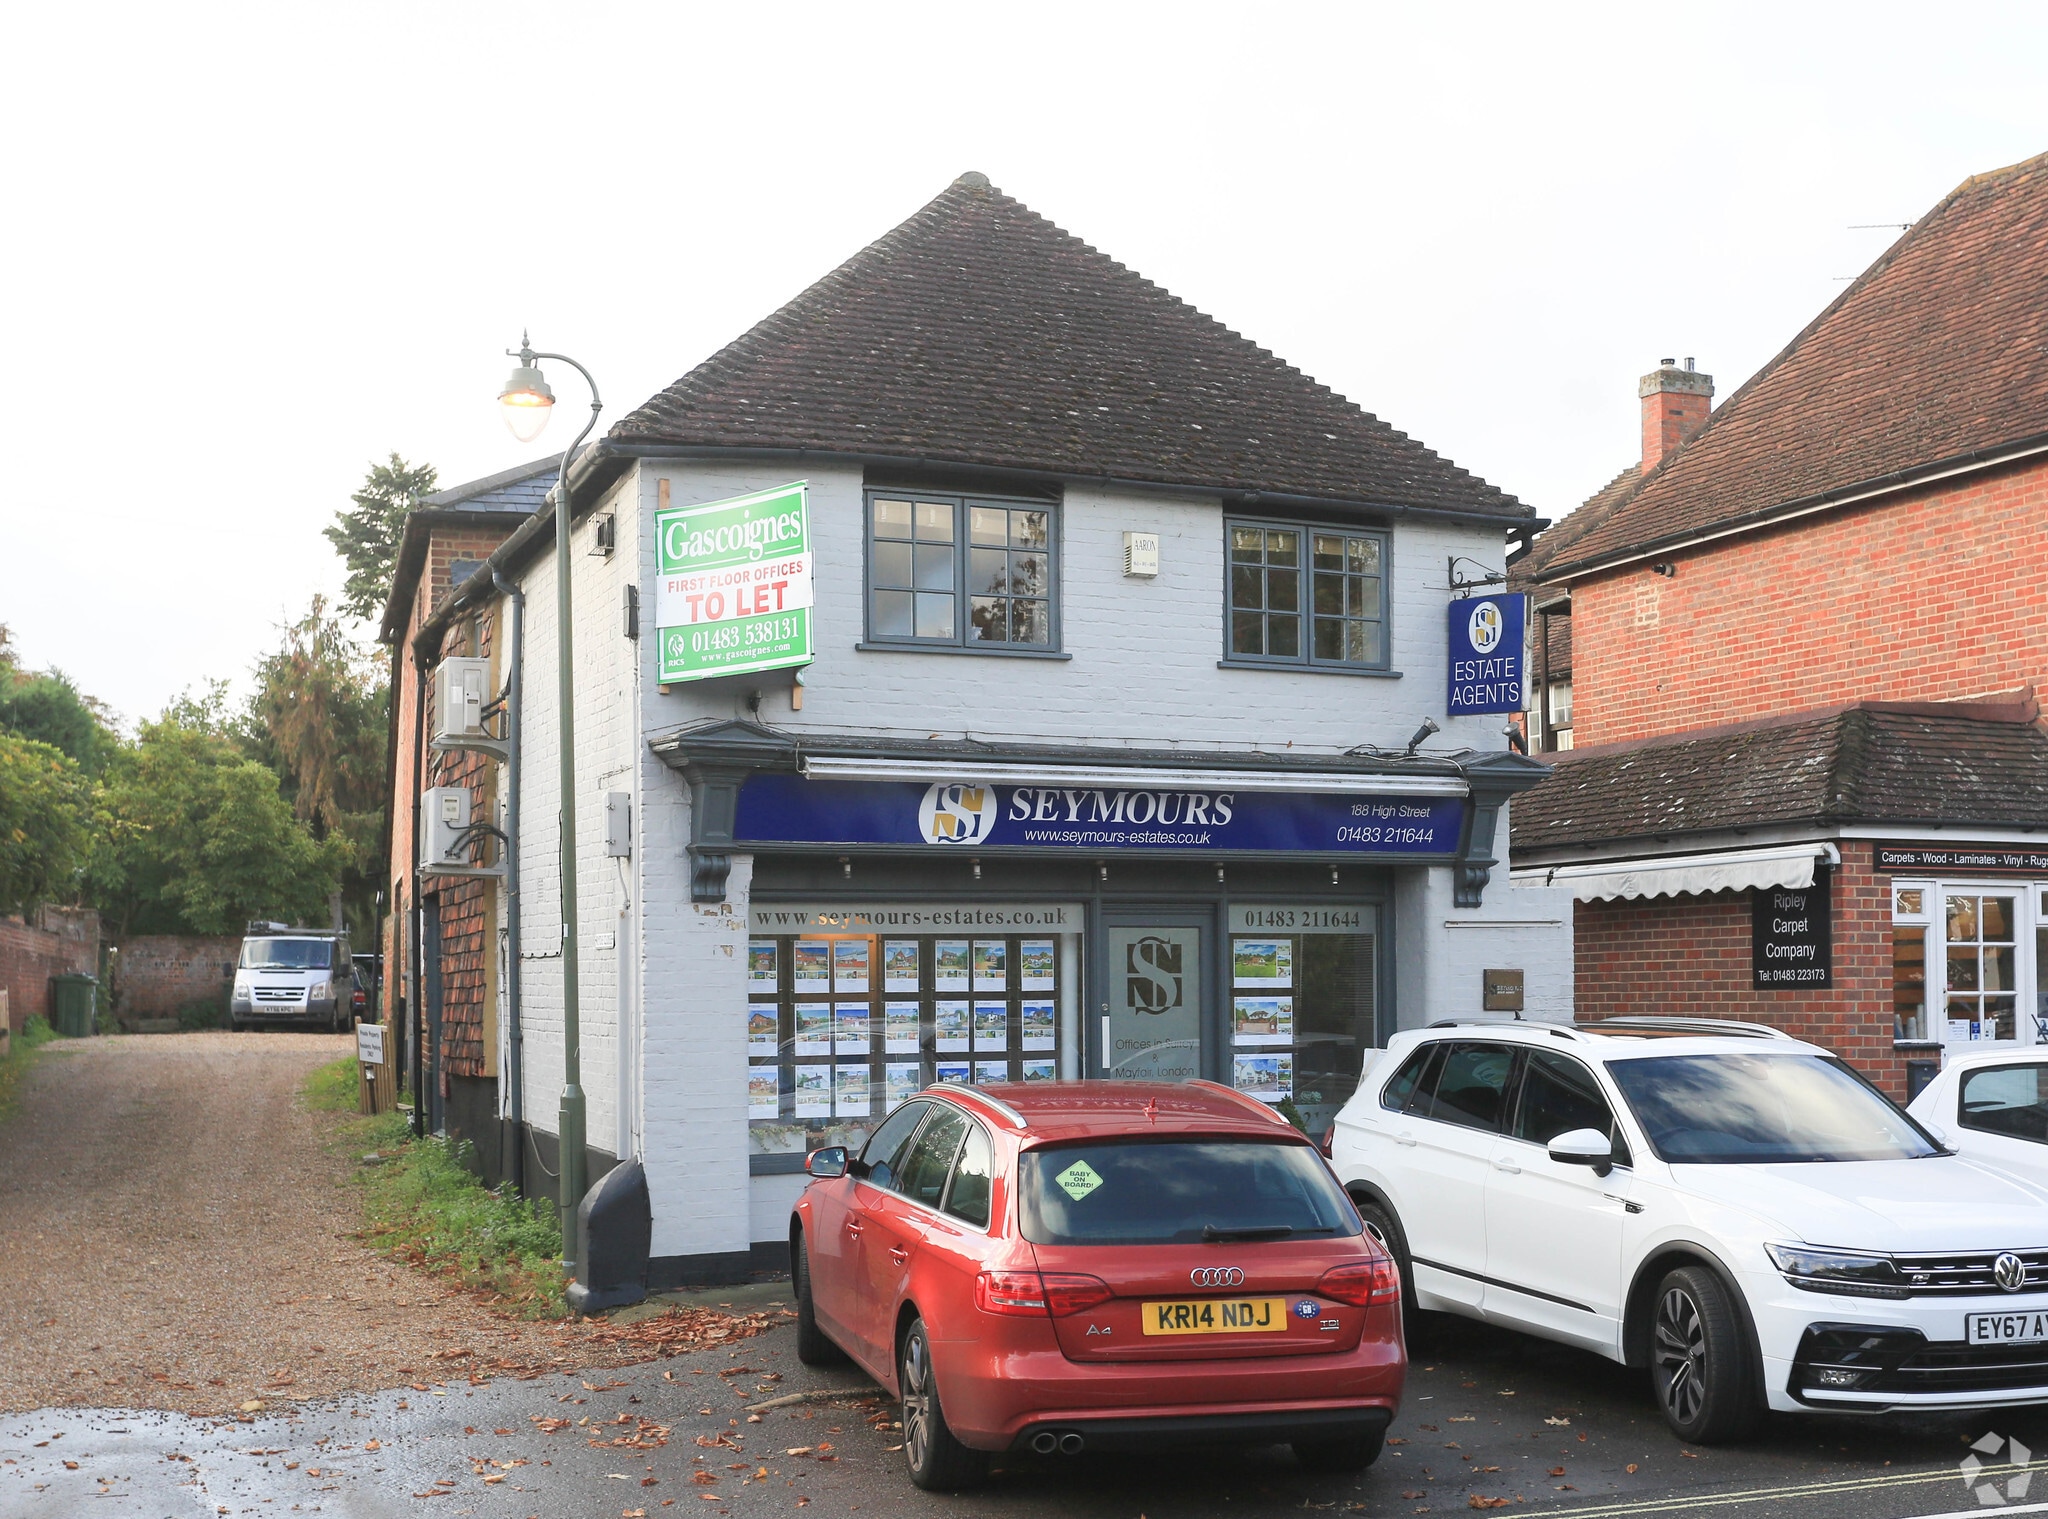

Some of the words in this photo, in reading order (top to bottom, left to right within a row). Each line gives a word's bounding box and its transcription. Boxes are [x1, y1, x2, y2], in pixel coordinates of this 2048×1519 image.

[665, 510, 800, 561] Gascoignes
[668, 577, 706, 593] FIRST
[709, 570, 750, 588] FLOOR
[754, 560, 803, 580] OFFICES
[686, 591, 725, 622] TO
[736, 581, 788, 616] LET
[692, 627, 740, 652] 01483
[744, 617, 799, 646] 538131
[701, 643, 791, 662] www.gascoignes.com
[668, 658, 685, 667] RICS
[1455, 657, 1515, 681] ESTATE
[1451, 682, 1519, 706] AGENTS
[1009, 787, 1234, 825] SEYMOURS
[1351, 804, 1369, 816] 188
[1372, 805, 1396, 819] High
[1399, 805, 1430, 818] Street
[1024, 829, 1211, 845] www.seymours-estates.co.uk
[1337, 826, 1381, 842] 01483
[1384, 827, 1433, 843] 211644
[1882, 852, 1914, 865] Carpets
[1923, 853, 1946, 864] Wood
[1955, 854, 1996, 865] Laminates
[2003, 855, 2023, 867] Vinyl
[1774, 893, 1806, 911] Ripley
[757, 907, 1068, 929] www.seymours-estates.co.uk
[1245, 910, 1295, 927] 01483
[1302, 911, 1360, 928] 211644
[1773, 918, 1808, 936] Carpet
[1766, 943, 1816, 960] Company
[1759, 970, 1771, 981] Tel:
[1773, 969, 1795, 981] 01483
[1798, 968, 1825, 980] 223173
[1115, 1039, 1151, 1050] Offices
[1158, 1066, 1194, 1077] London
[1158, 1304, 1214, 1329] KR14
[1222, 1302, 1271, 1327] NDJ
[1320, 1319, 1339, 1327] TDI
[1086, 1324, 1112, 1336] A4
[1978, 1316, 2027, 1339] EY67
[2033, 1314, 2048, 1336] A
